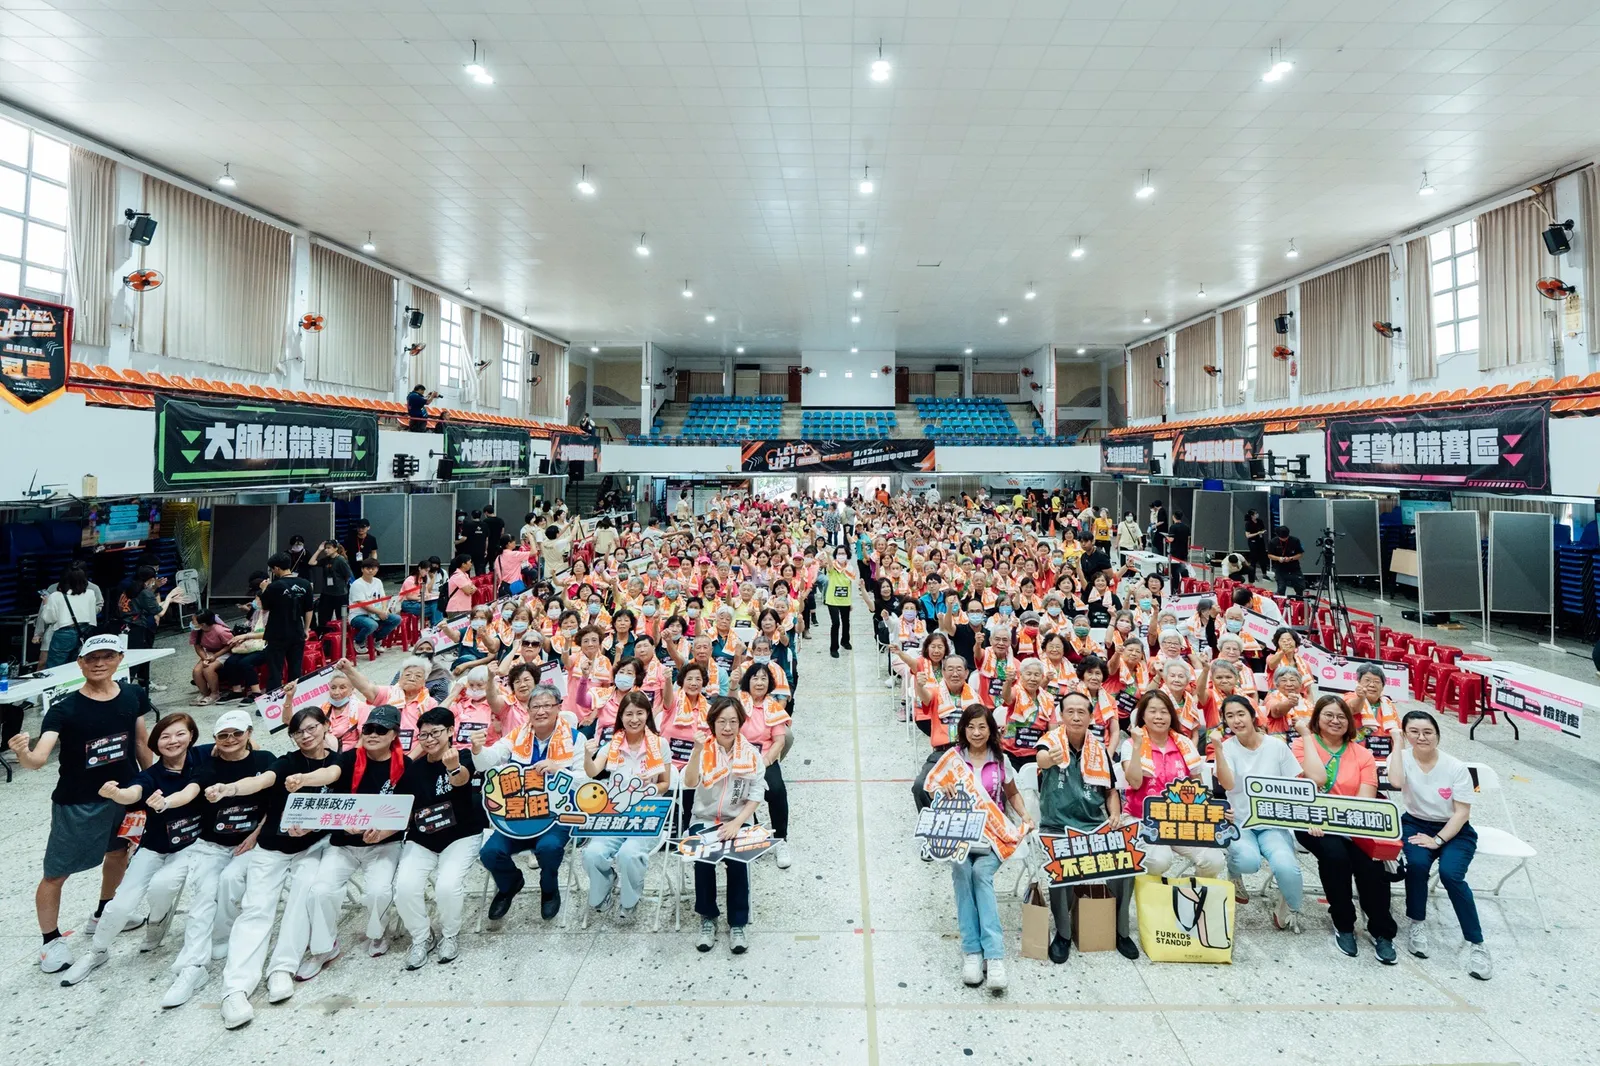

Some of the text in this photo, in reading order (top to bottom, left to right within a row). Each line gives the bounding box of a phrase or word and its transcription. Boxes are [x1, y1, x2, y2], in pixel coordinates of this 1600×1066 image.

[7, 308, 50, 321] LEVEL
[204, 422, 353, 460] 大師組競賽區
[1351, 428, 1499, 465] 至尊組競賽區
[777, 443, 812, 457] LEVEL
[768, 455, 795, 471] UP!
[1543, 705, 1580, 729] 檢錄處
[1265, 783, 1310, 797] ONLINE
[290, 797, 356, 811] 屏東縣政府
[319, 812, 372, 827] 希望城市
[1256, 800, 1393, 832] 銀髮高手上線啦!
[1052, 830, 1126, 859] 秀出你的
[1060, 851, 1134, 878] 不老魅力
[1156, 930, 1191, 940] FURKIDS
[1156, 937, 1191, 947] STANDUP
